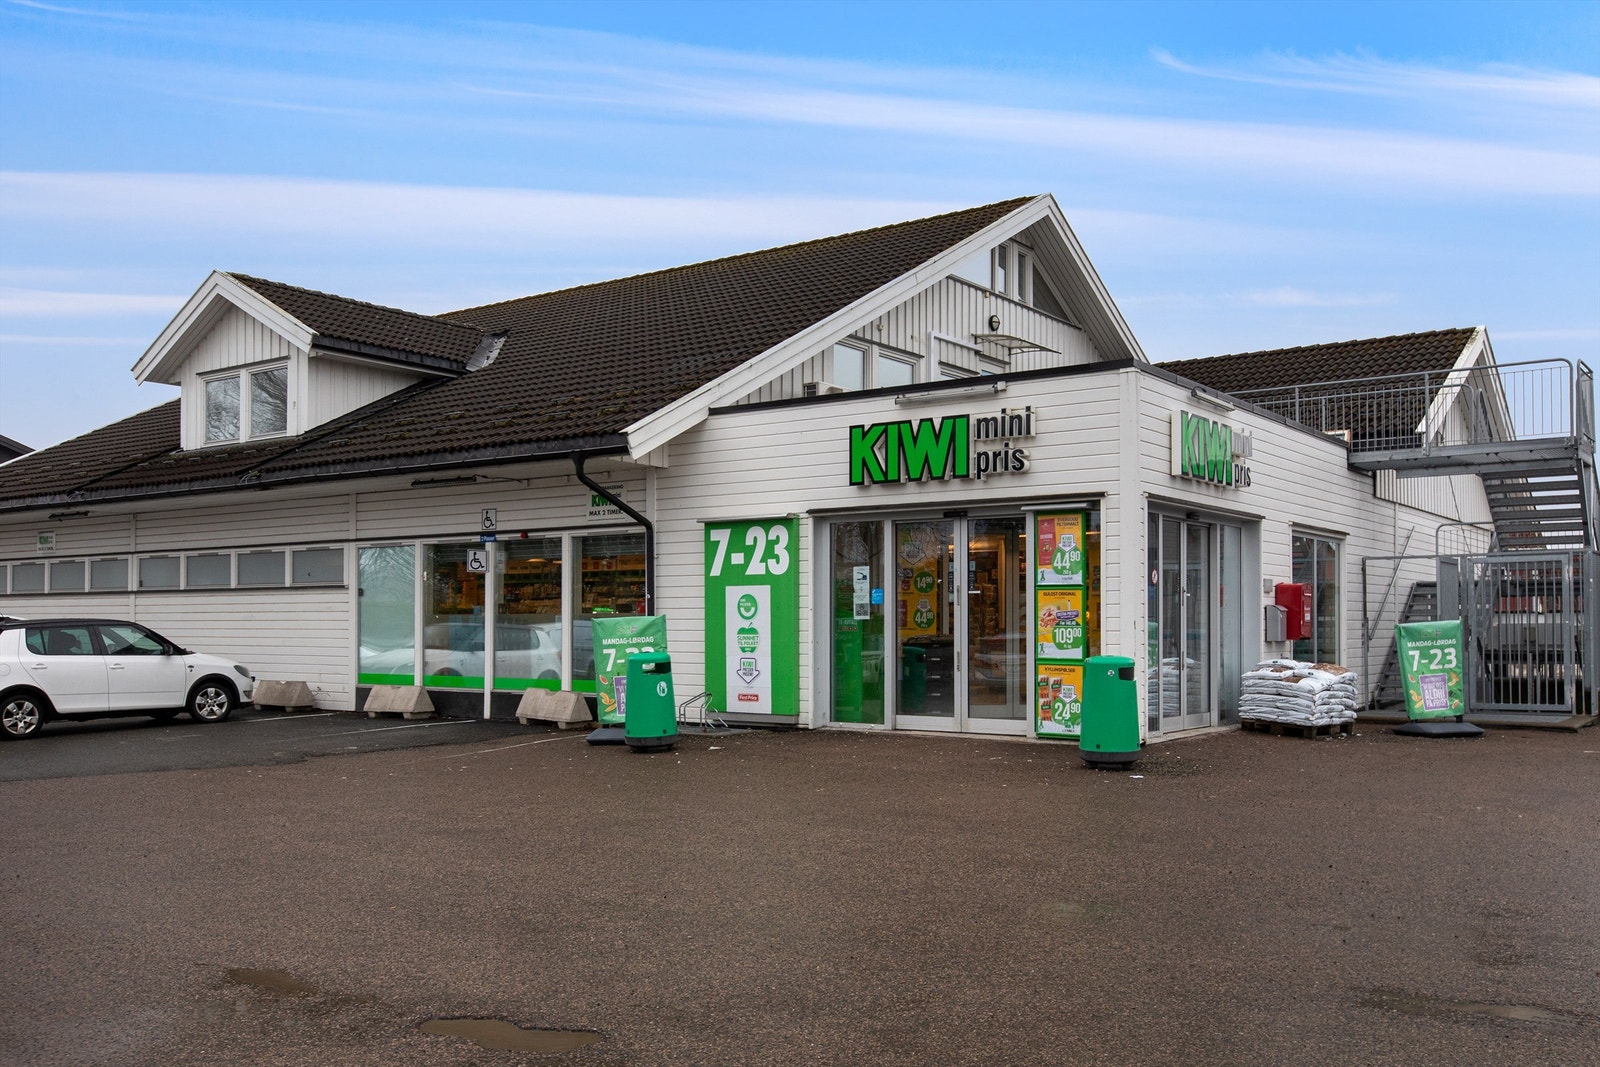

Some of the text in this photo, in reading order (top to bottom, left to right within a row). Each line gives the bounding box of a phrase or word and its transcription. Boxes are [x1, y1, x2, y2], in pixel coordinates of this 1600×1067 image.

[976, 406, 1032, 439] mini
[849, 414, 970, 486] KIWI
[1180, 410, 1233, 486] KIWI
[1232, 427, 1253, 457] mini
[976, 442, 1026, 480] pris
[1234, 459, 1252, 488] pris
[709, 524, 790, 577] 7-23
[602, 636, 654, 645] MANDAG-LØRDAG
[1407, 639, 1456, 647] MANDAG-LØRDAG
[1408, 647, 1457, 672] 7-23
